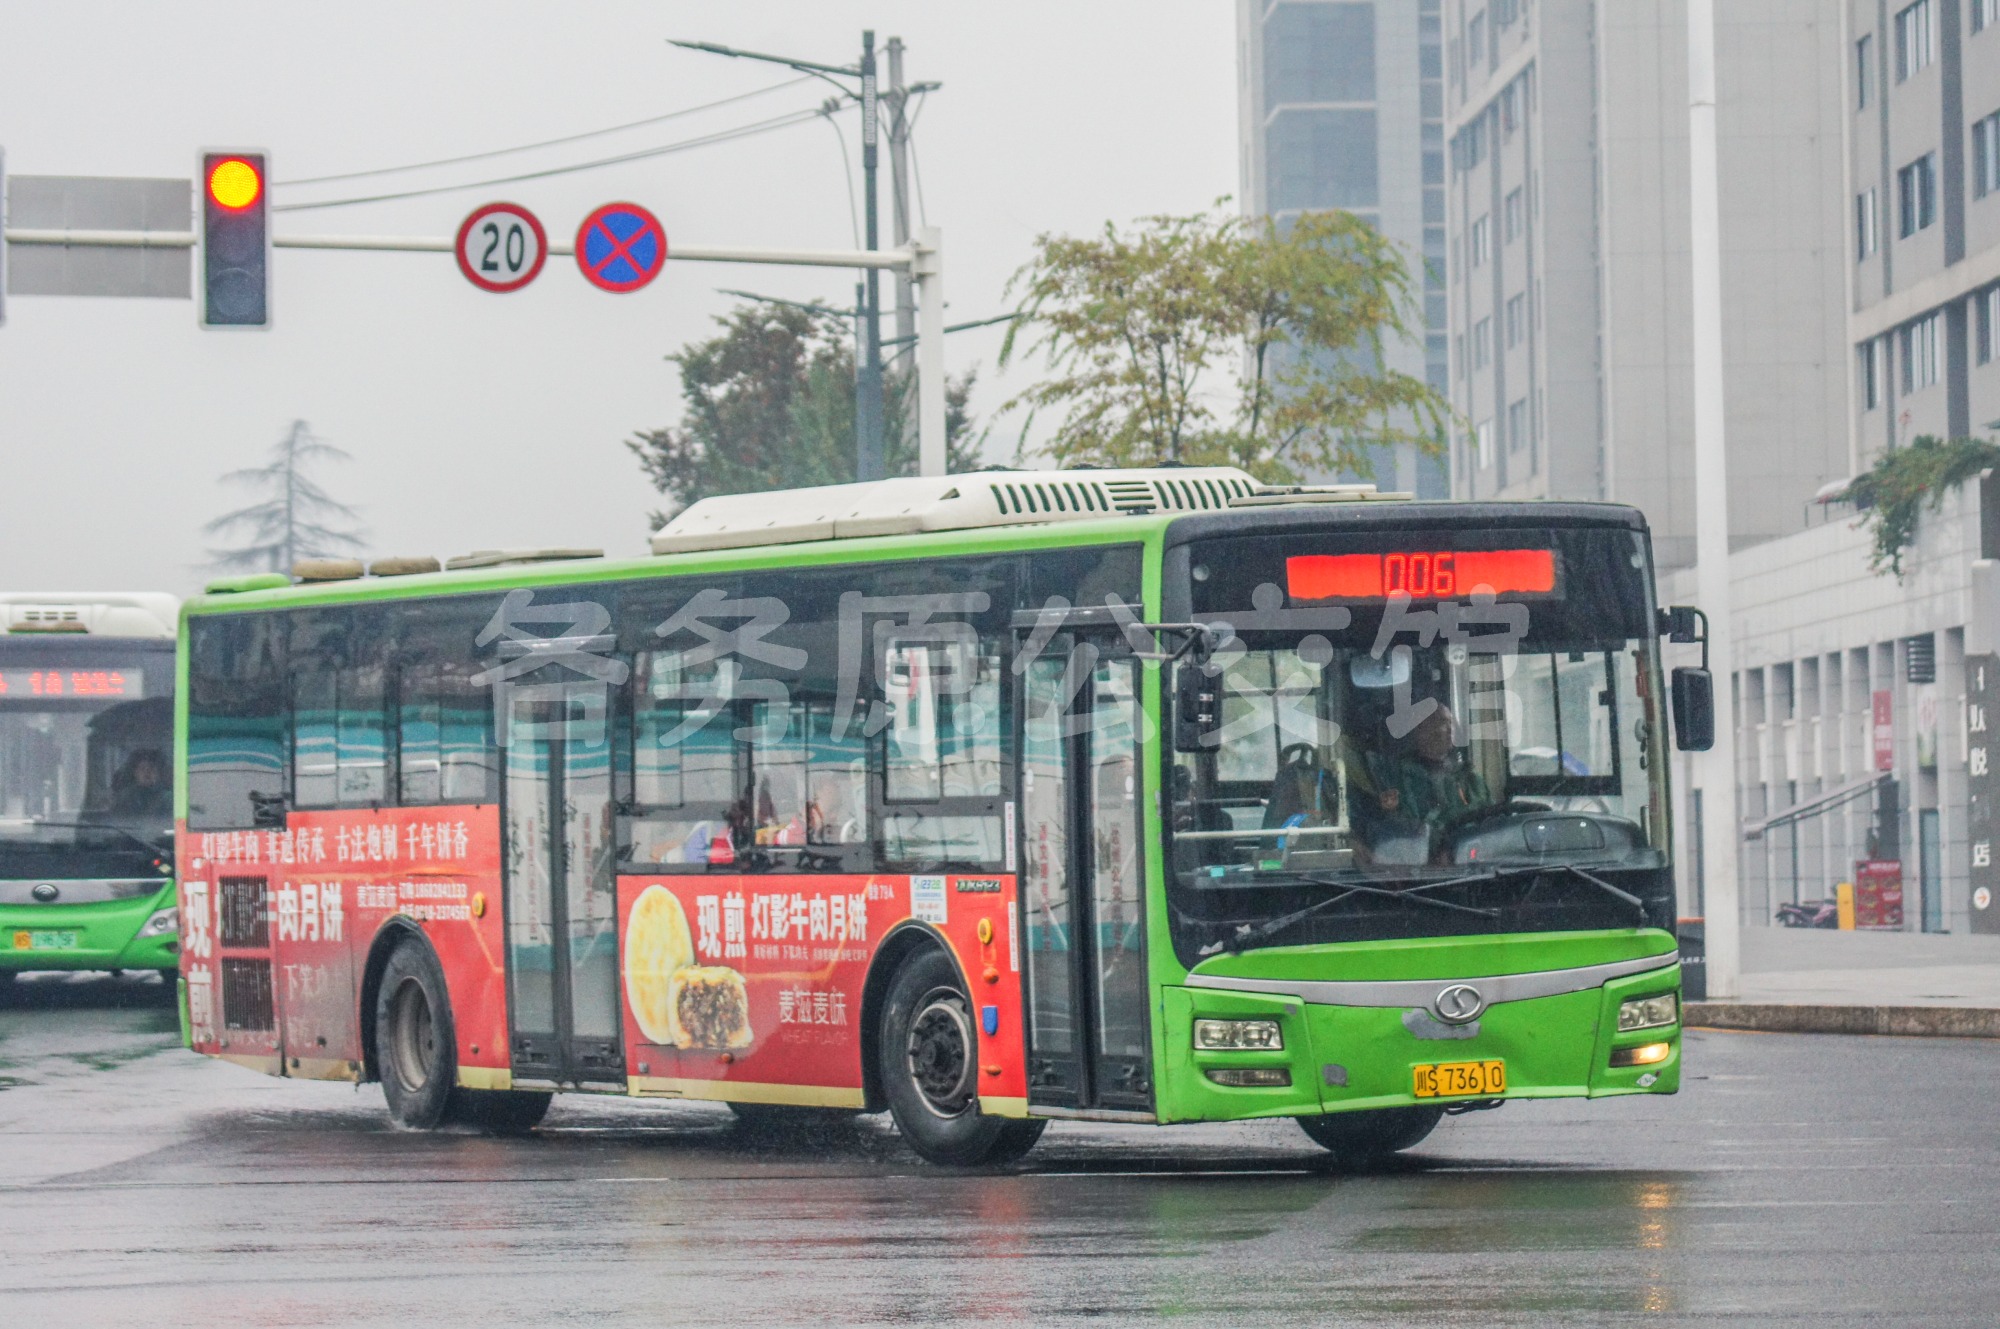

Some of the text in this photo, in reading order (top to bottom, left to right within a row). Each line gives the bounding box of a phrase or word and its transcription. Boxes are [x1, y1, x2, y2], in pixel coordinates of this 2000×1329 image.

[481, 222, 526, 272] 20
[1383, 552, 1455, 596] 006
[405, 821, 469, 860] 千年饼香
[696, 890, 747, 959] 现煎
[751, 892, 868, 942] 灯影牛肉月饼
[778, 984, 848, 1026] 麦滋麦味
